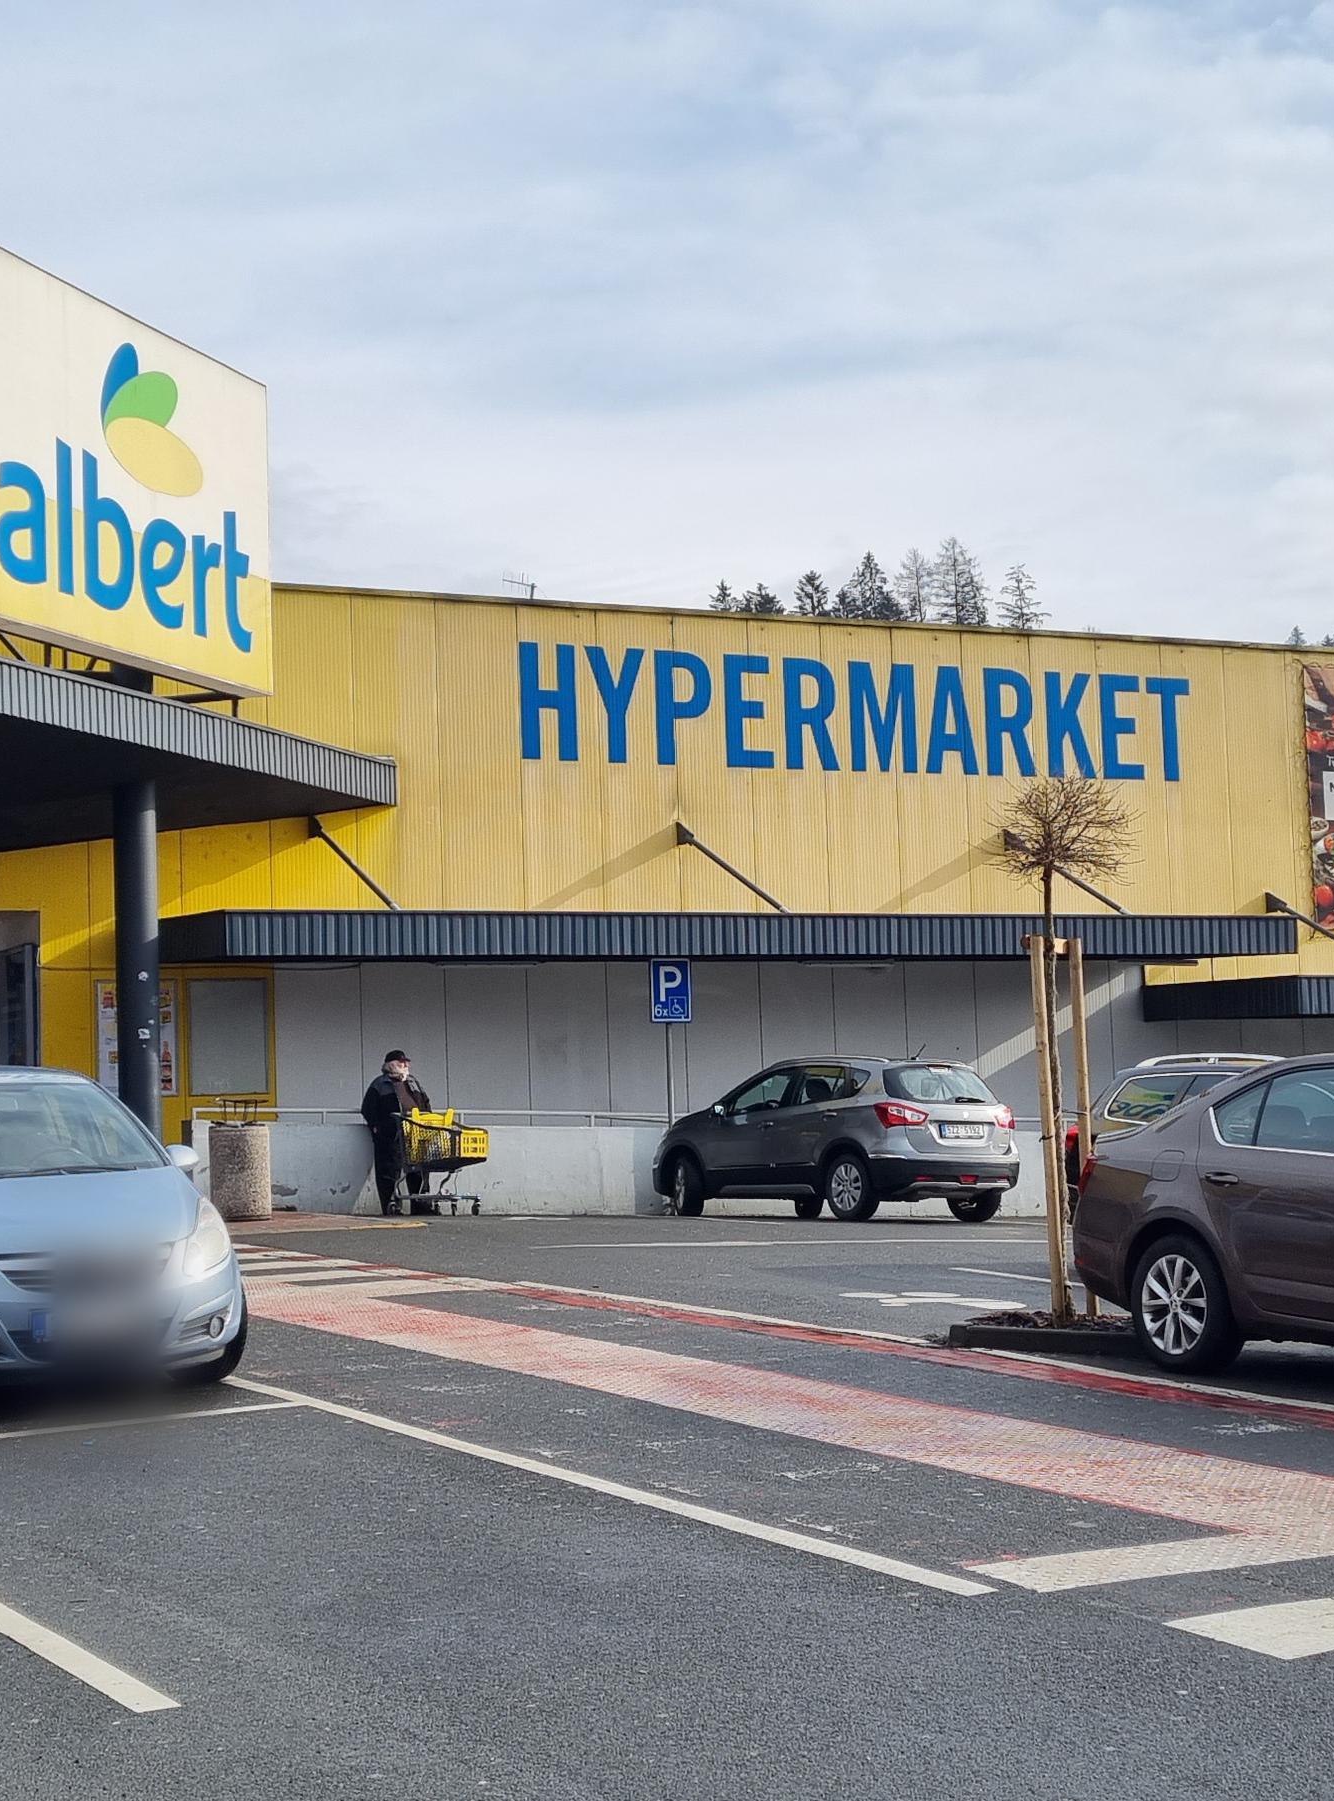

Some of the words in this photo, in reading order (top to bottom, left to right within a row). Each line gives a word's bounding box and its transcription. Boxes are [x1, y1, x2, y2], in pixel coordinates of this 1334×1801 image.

[518, 641, 1190, 782] HYPERMARKET
[659, 966, 682, 1002] P
[654, 1004, 668, 1017] 6x
